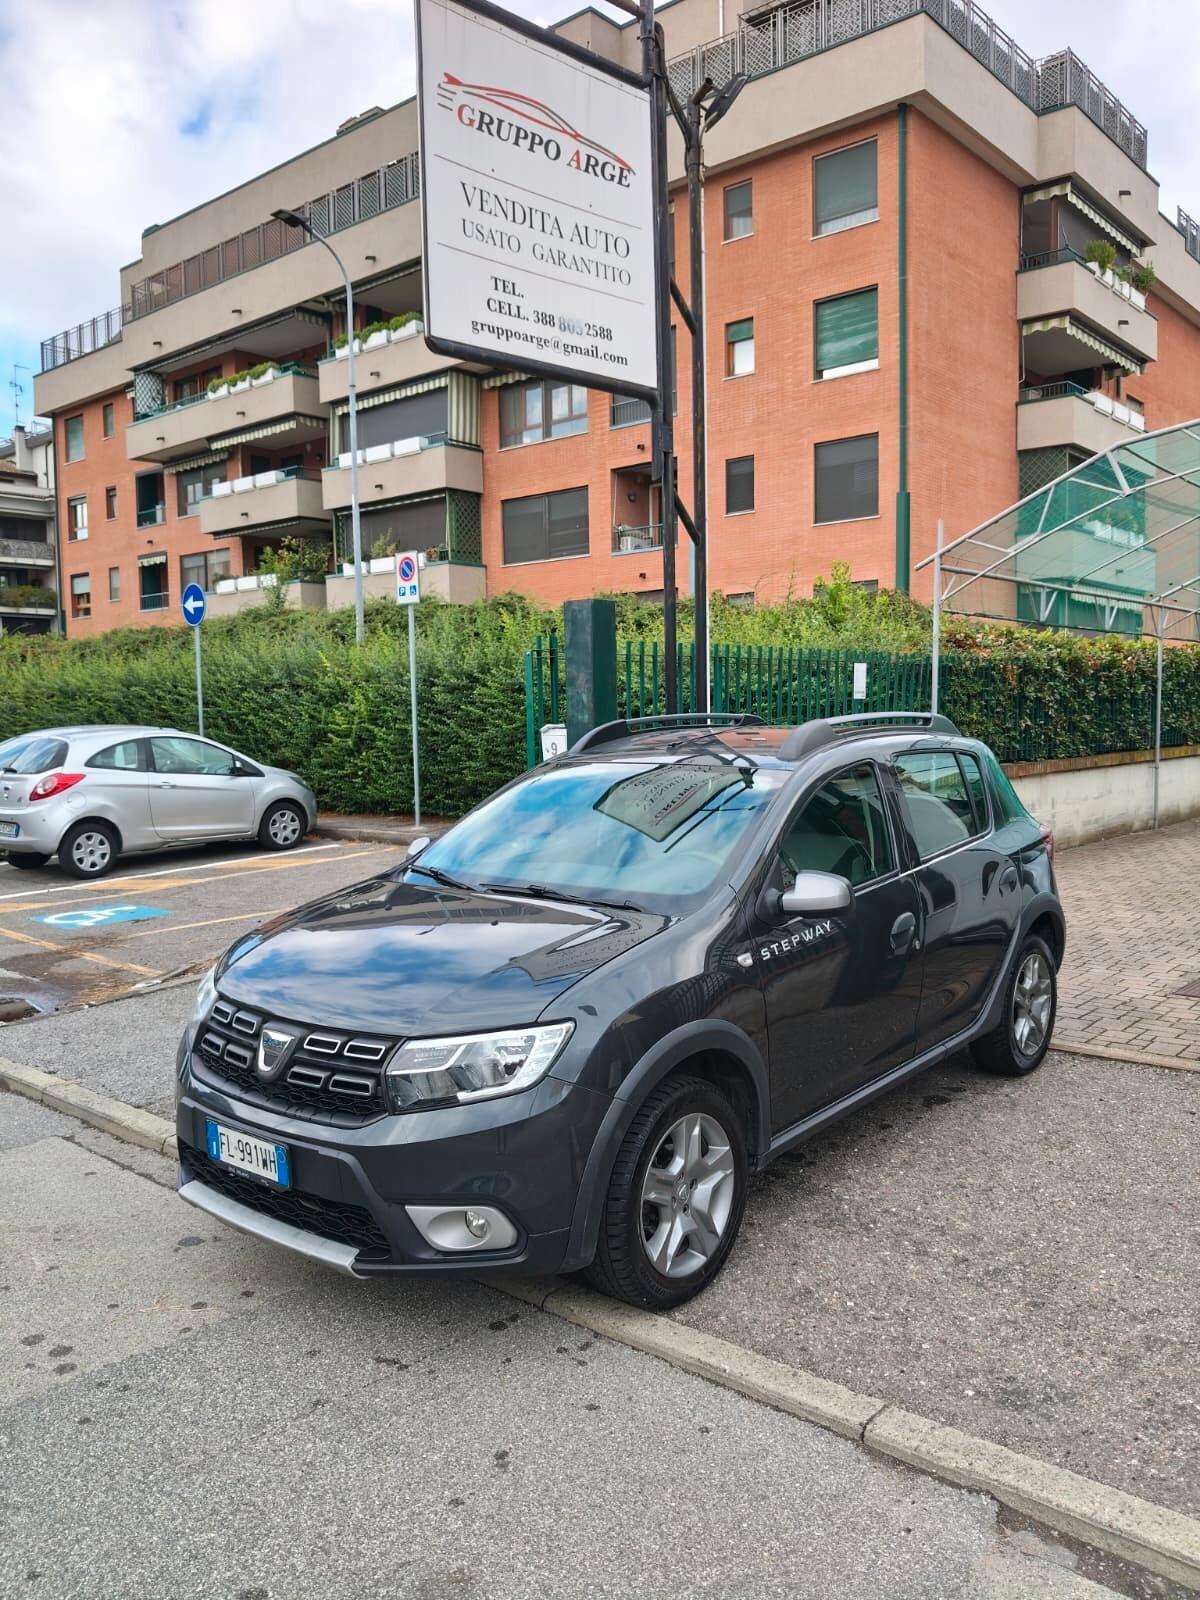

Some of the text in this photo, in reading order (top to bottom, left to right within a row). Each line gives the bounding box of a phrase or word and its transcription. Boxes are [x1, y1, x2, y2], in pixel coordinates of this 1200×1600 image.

[457, 103, 631, 188] GRUPPO ARGE
[460, 181, 630, 259] VENDITA AUTO
[461, 218, 632, 286] USATO GARANTITO
[490, 275, 524, 298] TEL.
[486, 297, 529, 321] CELL.
[533, 310, 556, 328] 388
[585, 322, 613, 341] 2588
[471, 320, 628, 366] gruppoarge@gmail.com
[760, 920, 832, 961] STEPWAY
